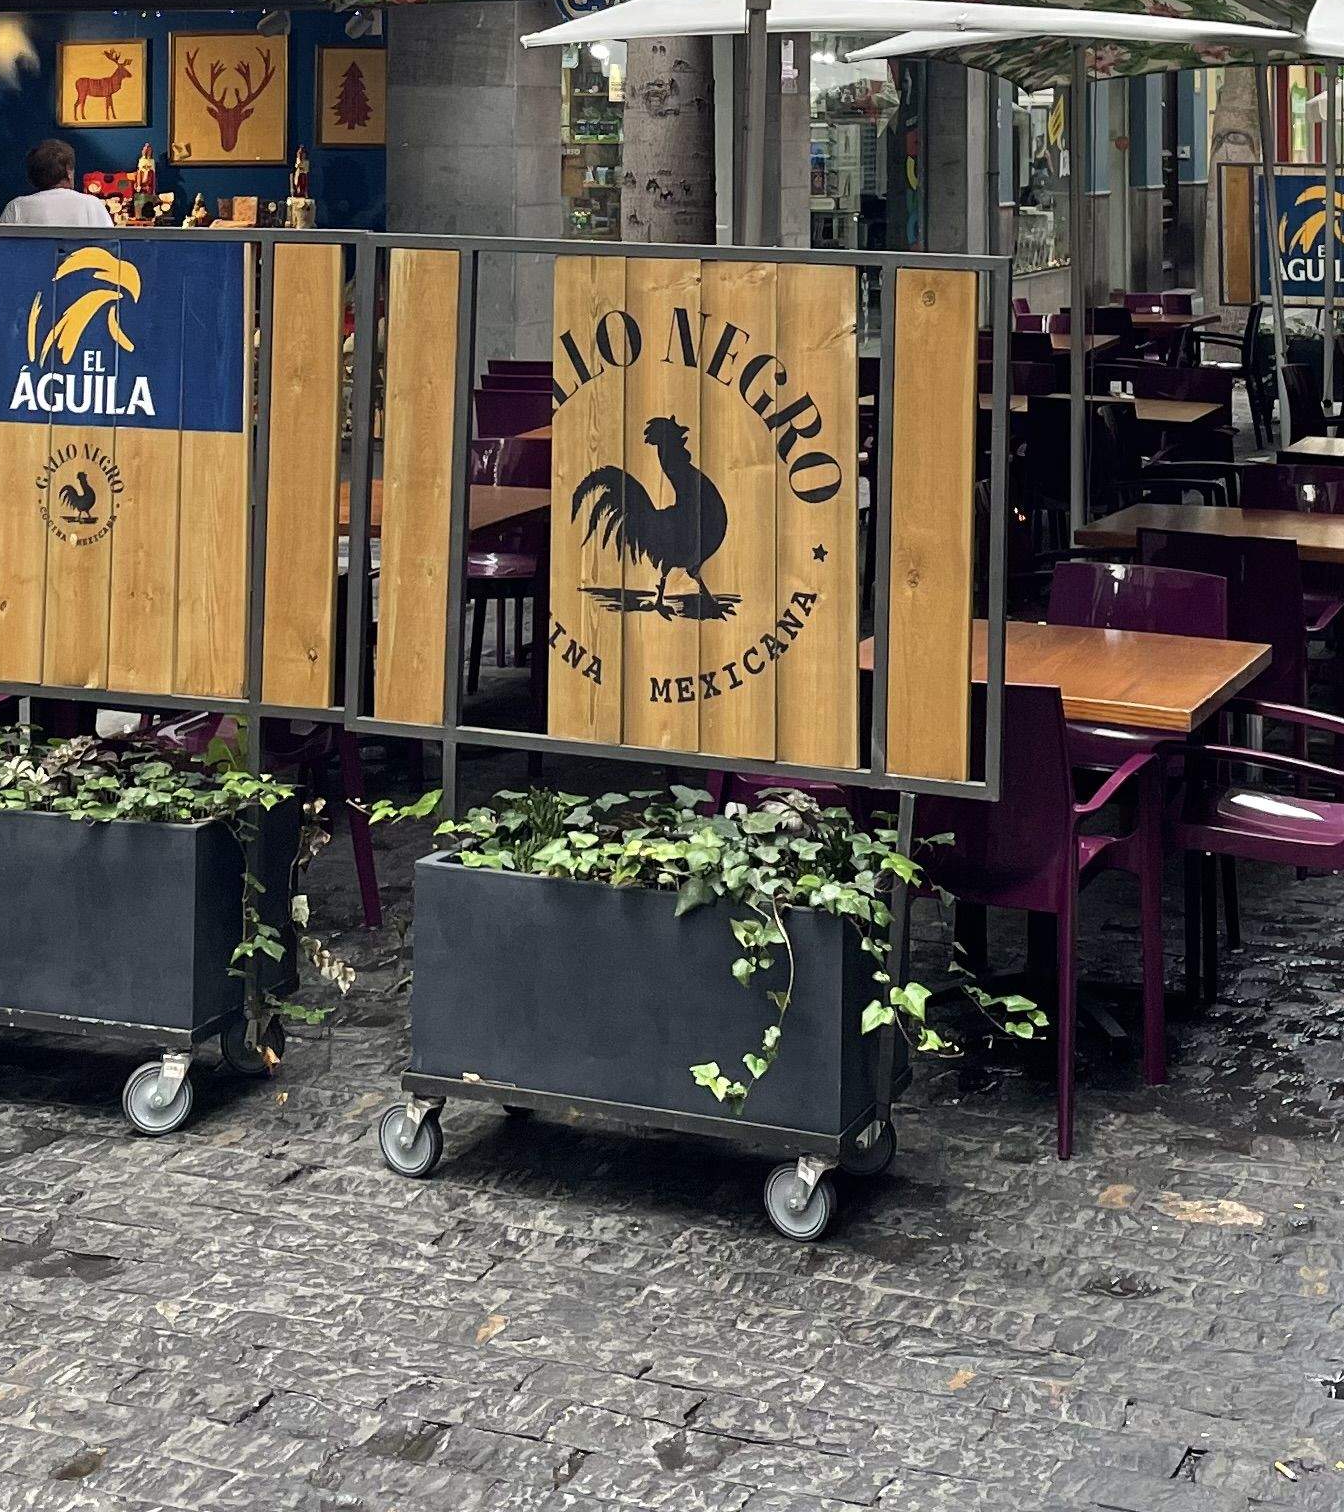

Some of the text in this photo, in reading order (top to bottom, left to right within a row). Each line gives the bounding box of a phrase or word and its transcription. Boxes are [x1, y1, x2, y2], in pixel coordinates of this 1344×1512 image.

[83, 350, 105, 372] EL
[9, 365, 156, 416] ÁGUILA
[660, 307, 843, 504] NEGRO
[36, 443, 125, 494] GALLO NEGRO
[649, 588, 817, 704] MEXICANA
